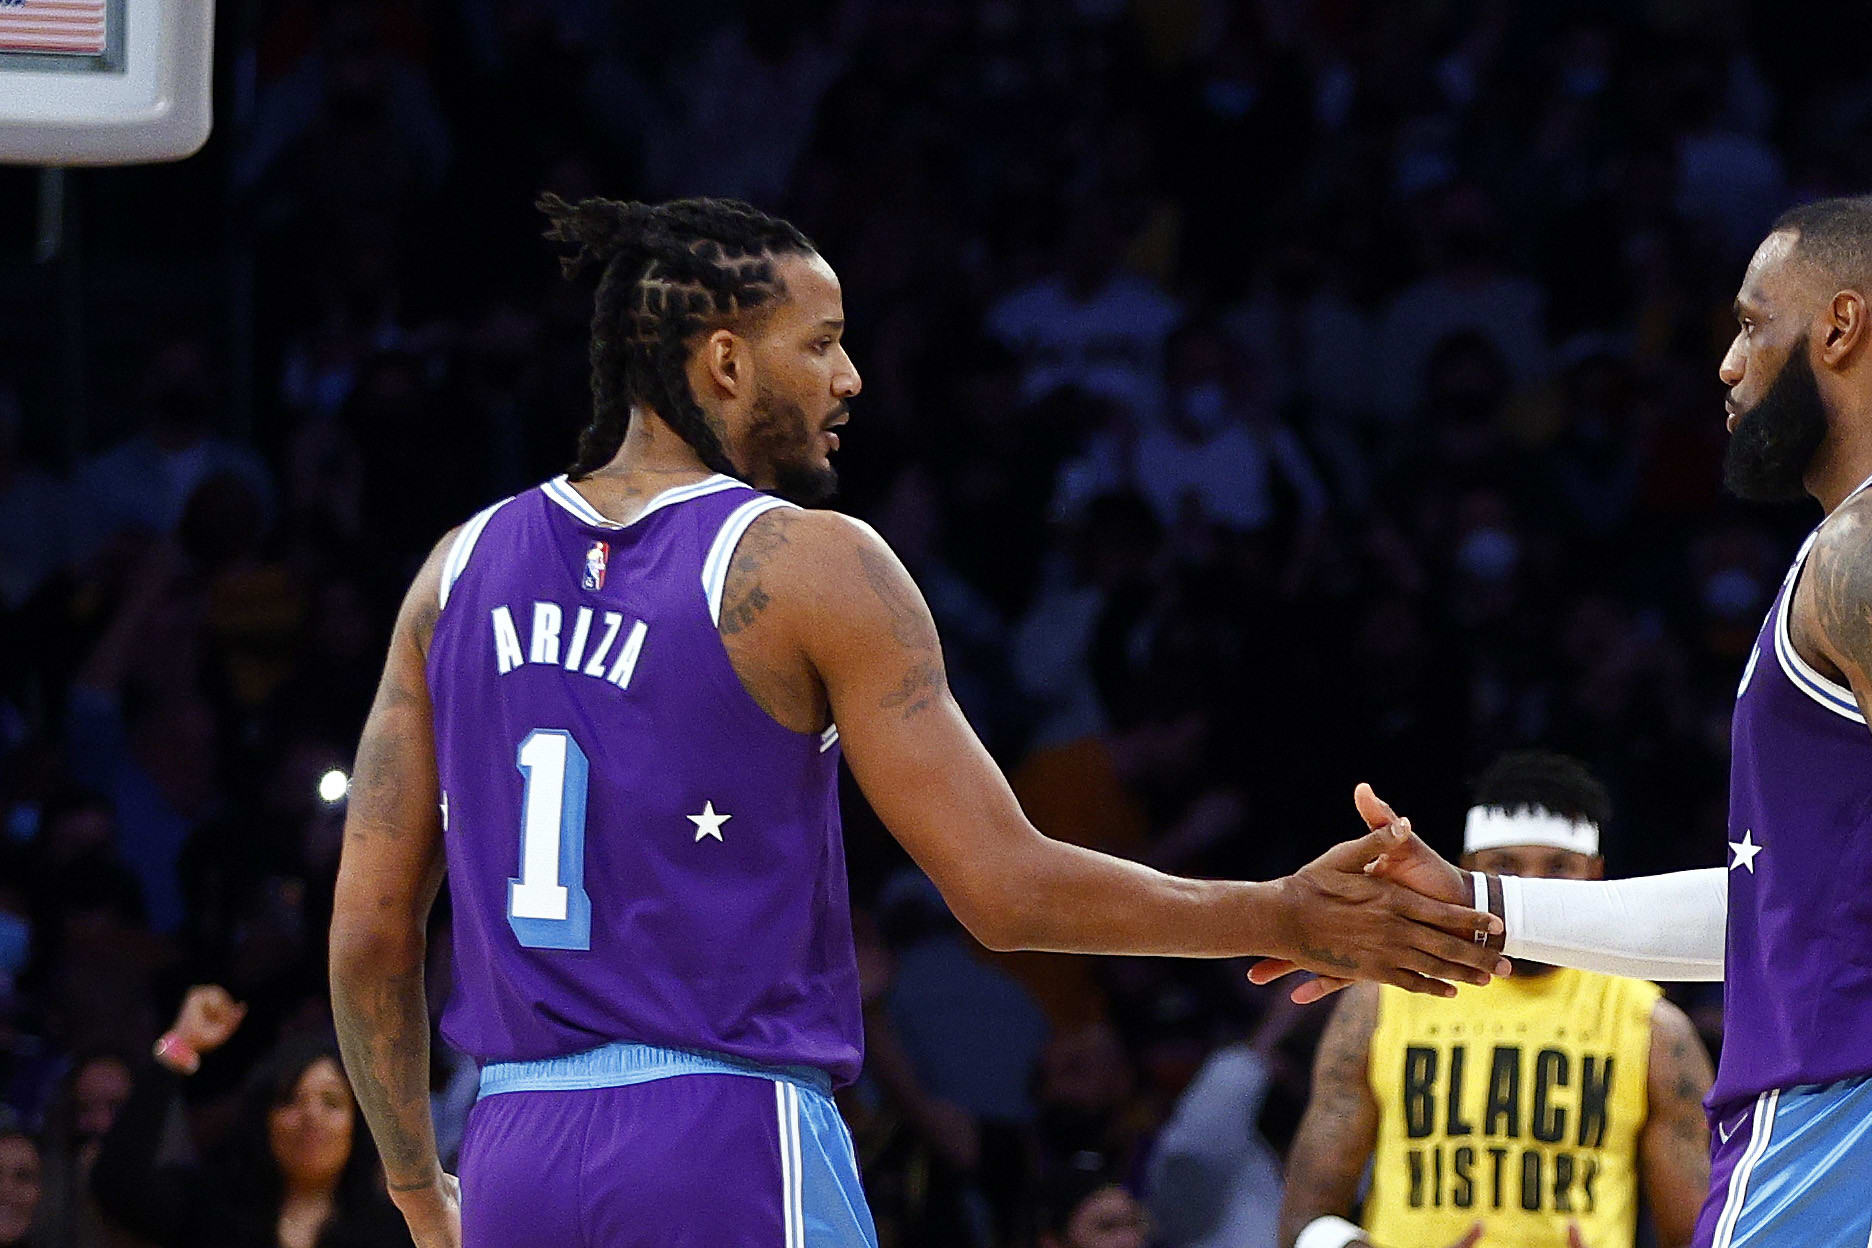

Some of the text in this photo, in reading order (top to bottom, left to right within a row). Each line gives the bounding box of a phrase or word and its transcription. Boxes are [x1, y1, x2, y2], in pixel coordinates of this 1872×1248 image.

[491, 601, 648, 690] ARIZA
[507, 729, 591, 951] 1
[1406, 1046, 1614, 1147] BLACK
